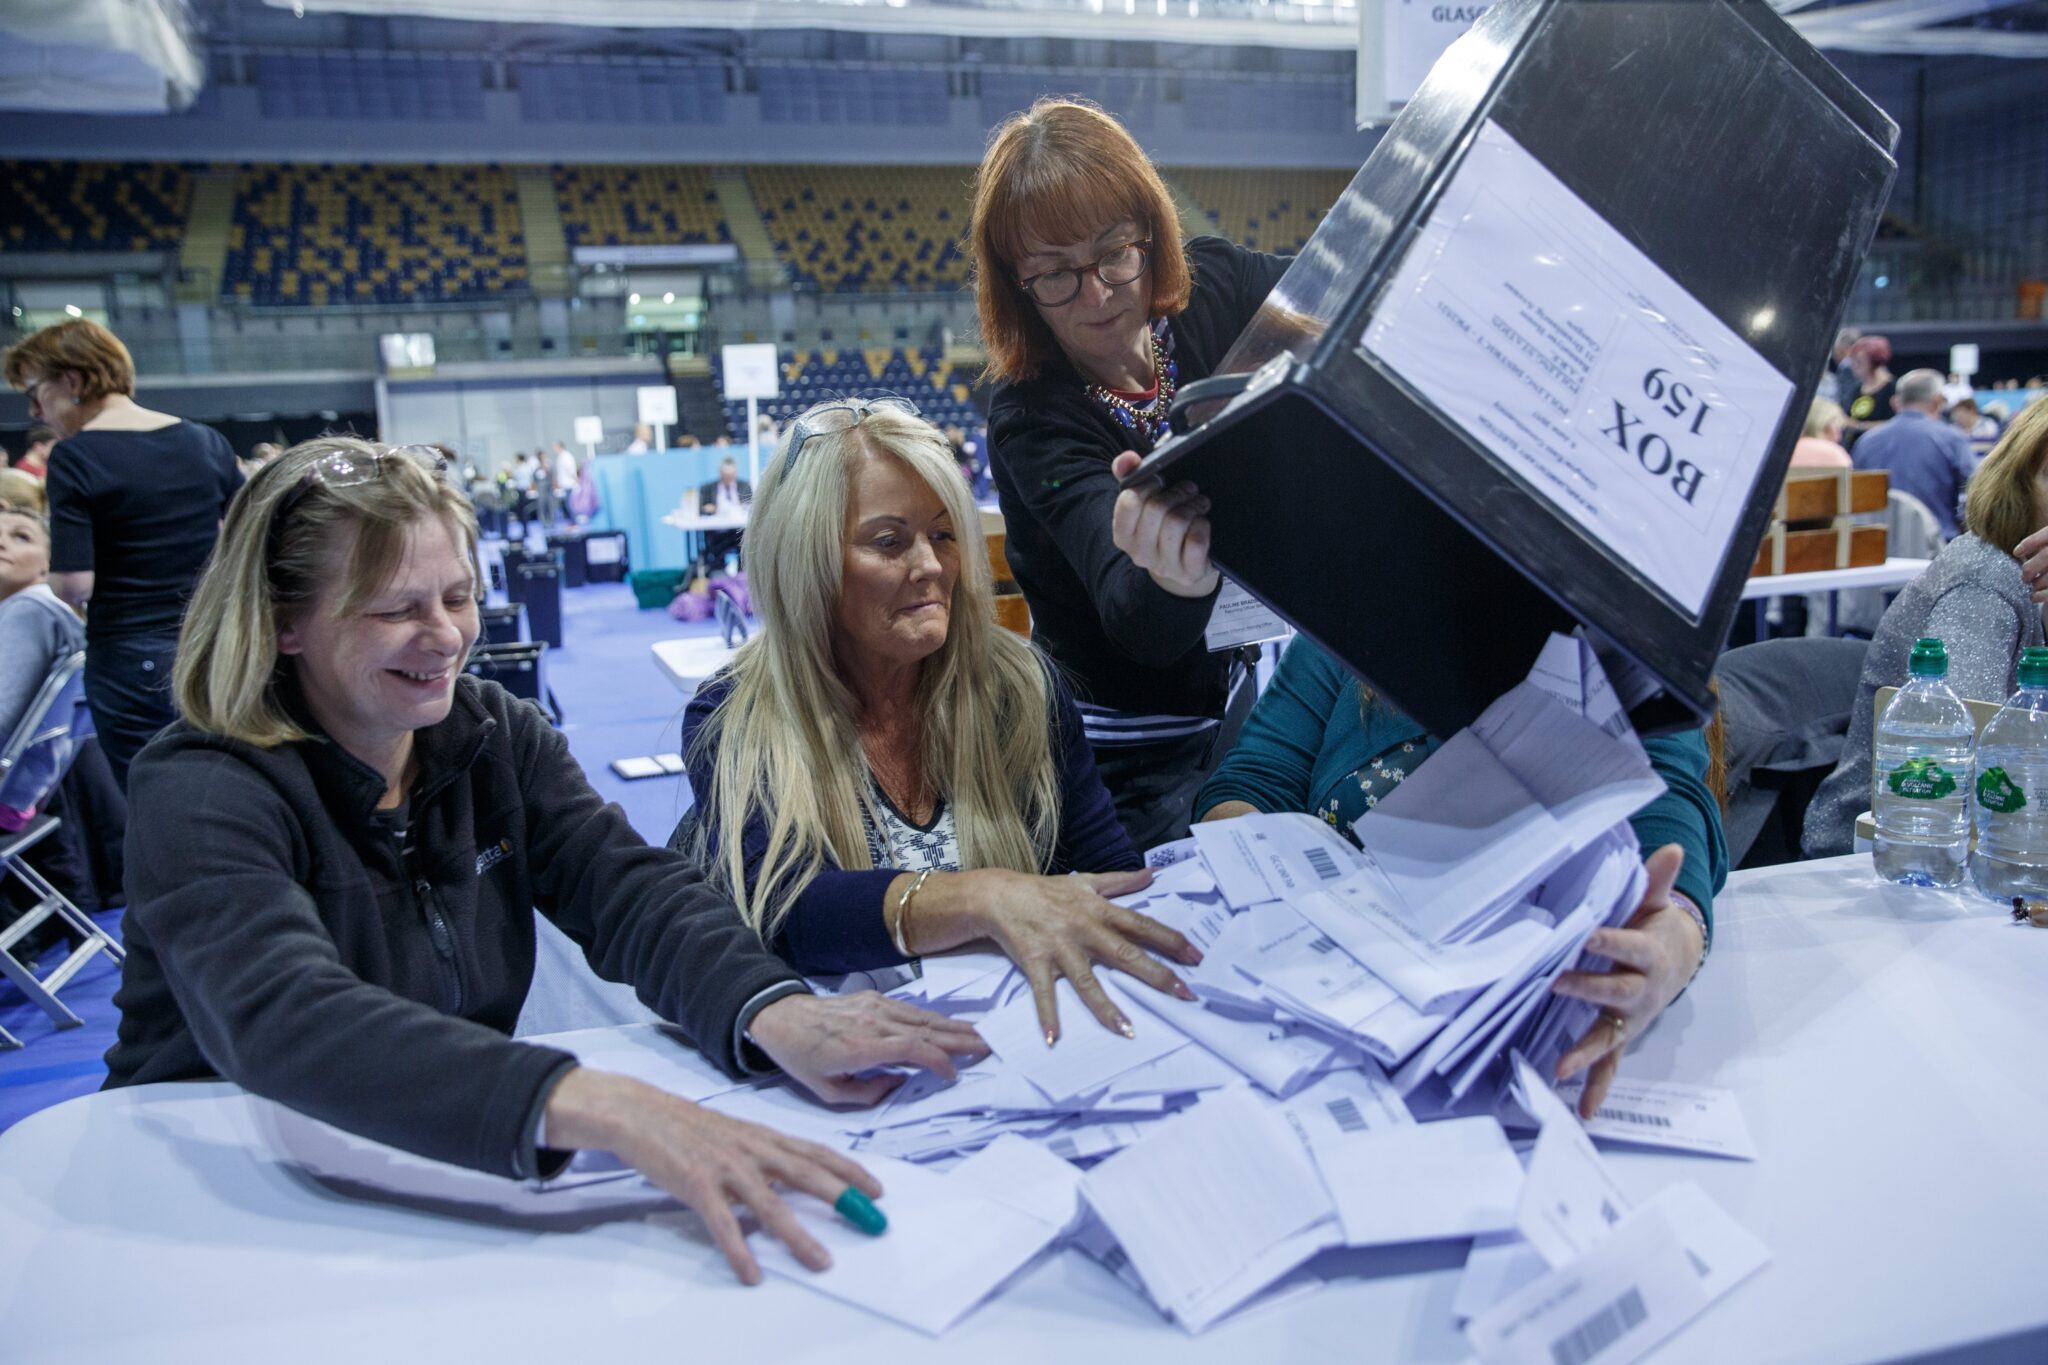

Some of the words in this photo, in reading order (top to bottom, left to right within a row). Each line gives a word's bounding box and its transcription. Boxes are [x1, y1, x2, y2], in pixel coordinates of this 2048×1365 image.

[1477, 335, 1524, 378] DISTRICT
[1490, 315, 1535, 357] STATION
[1524, 374, 1569, 416] POLLING
[1535, 352, 1579, 395] POLLING
[1643, 367, 1712, 436] 159
[1477, 413, 1517, 451] ELECTION
[1601, 399, 1706, 507] BOX
